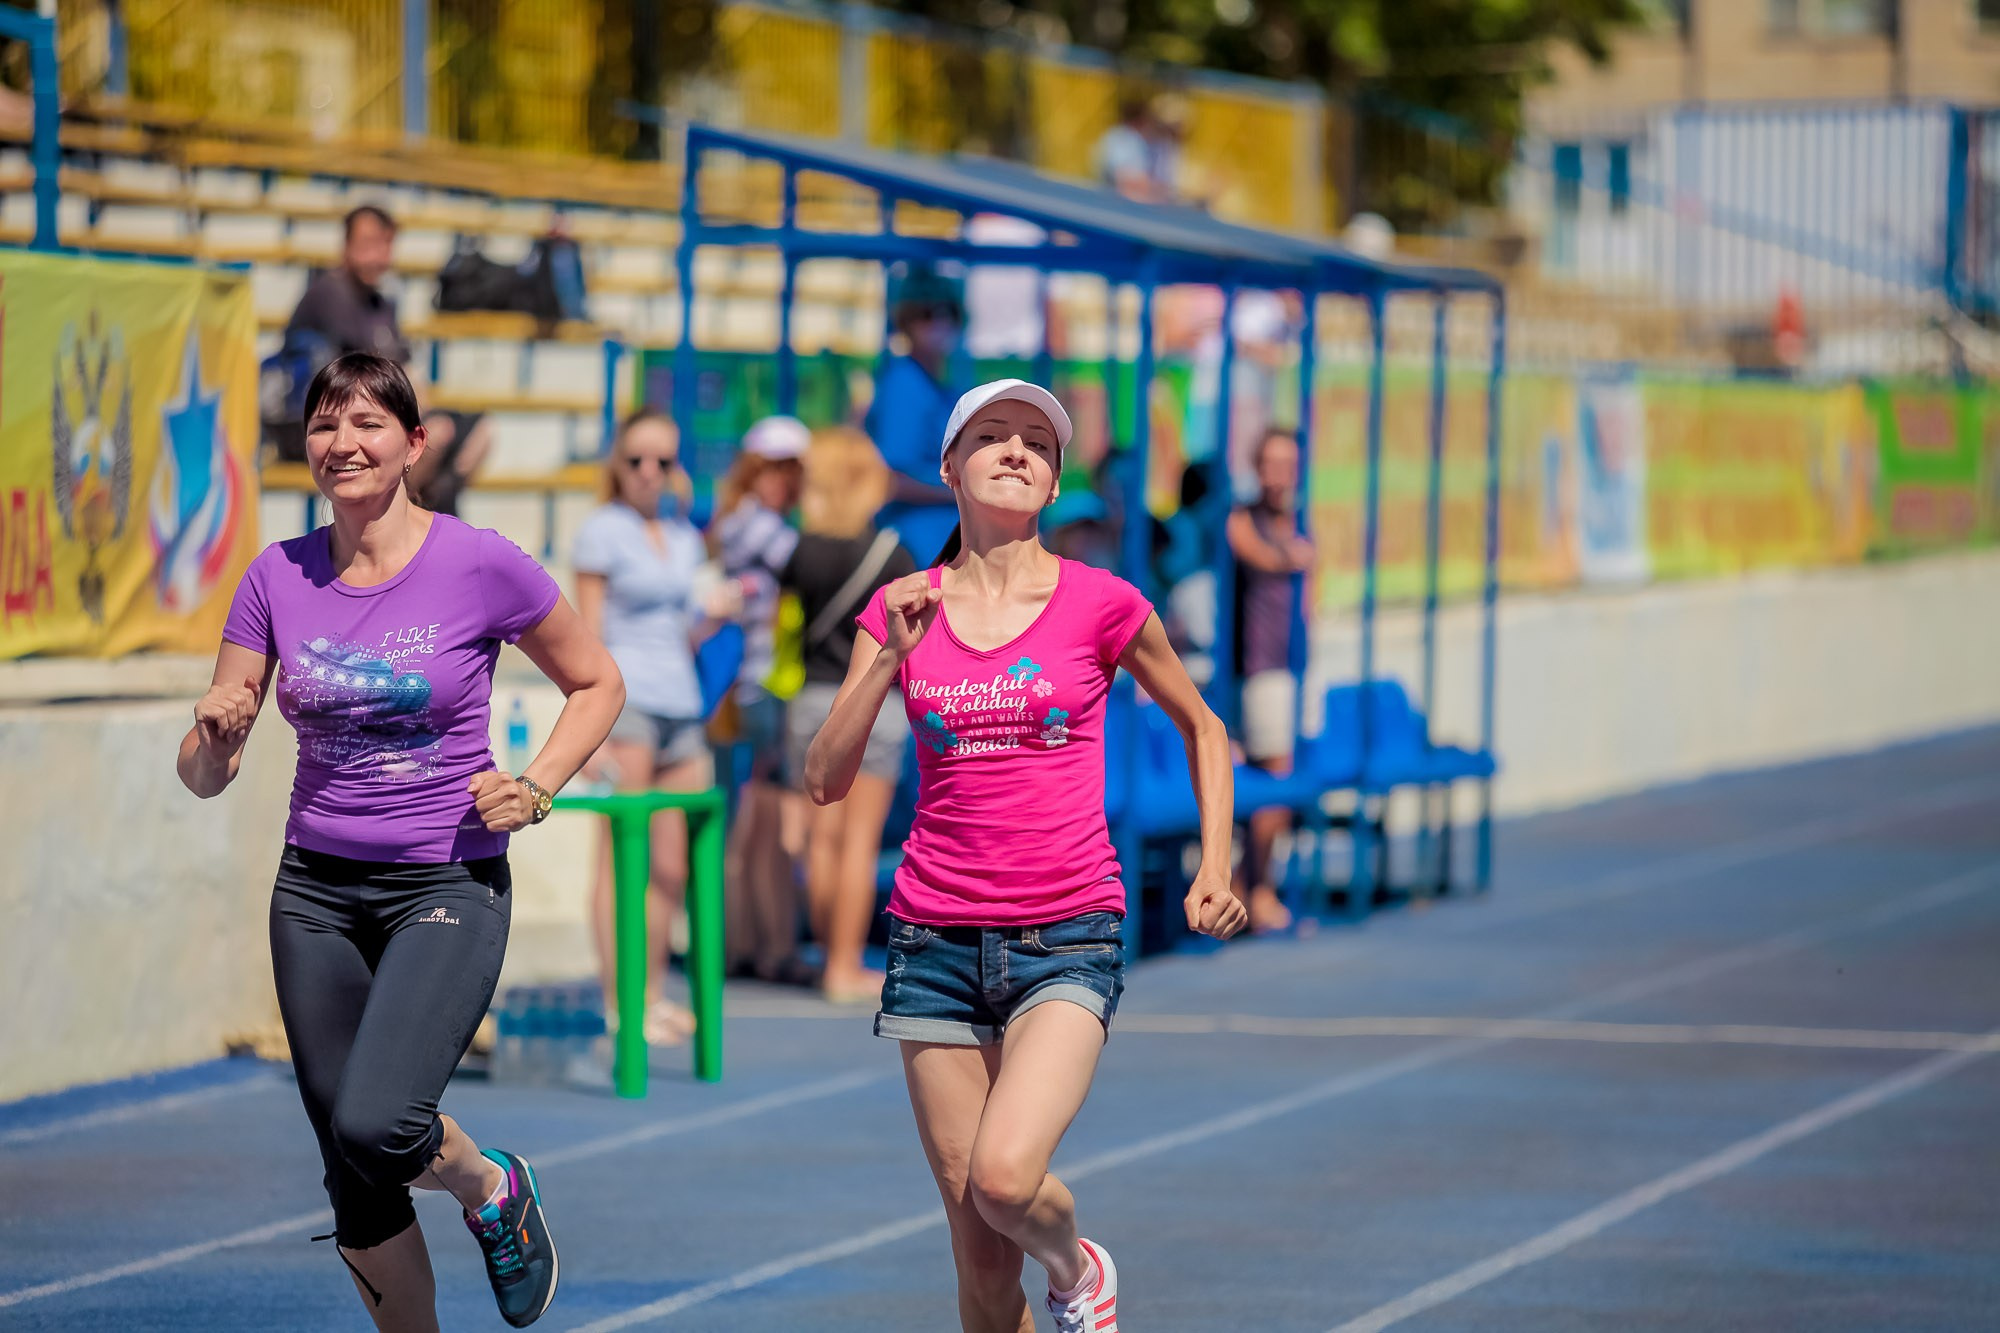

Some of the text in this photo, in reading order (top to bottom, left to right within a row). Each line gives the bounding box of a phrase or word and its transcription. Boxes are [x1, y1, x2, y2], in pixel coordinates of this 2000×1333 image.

[0, 488, 55, 631] ДА
[379, 623, 441, 647] I LIKE
[382, 642, 435, 664] sports
[909, 672, 1027, 698] Wonderful
[938, 695, 1029, 716] Holiday
[996, 712, 1035, 722] WAVES
[953, 734, 1020, 757] Beach
